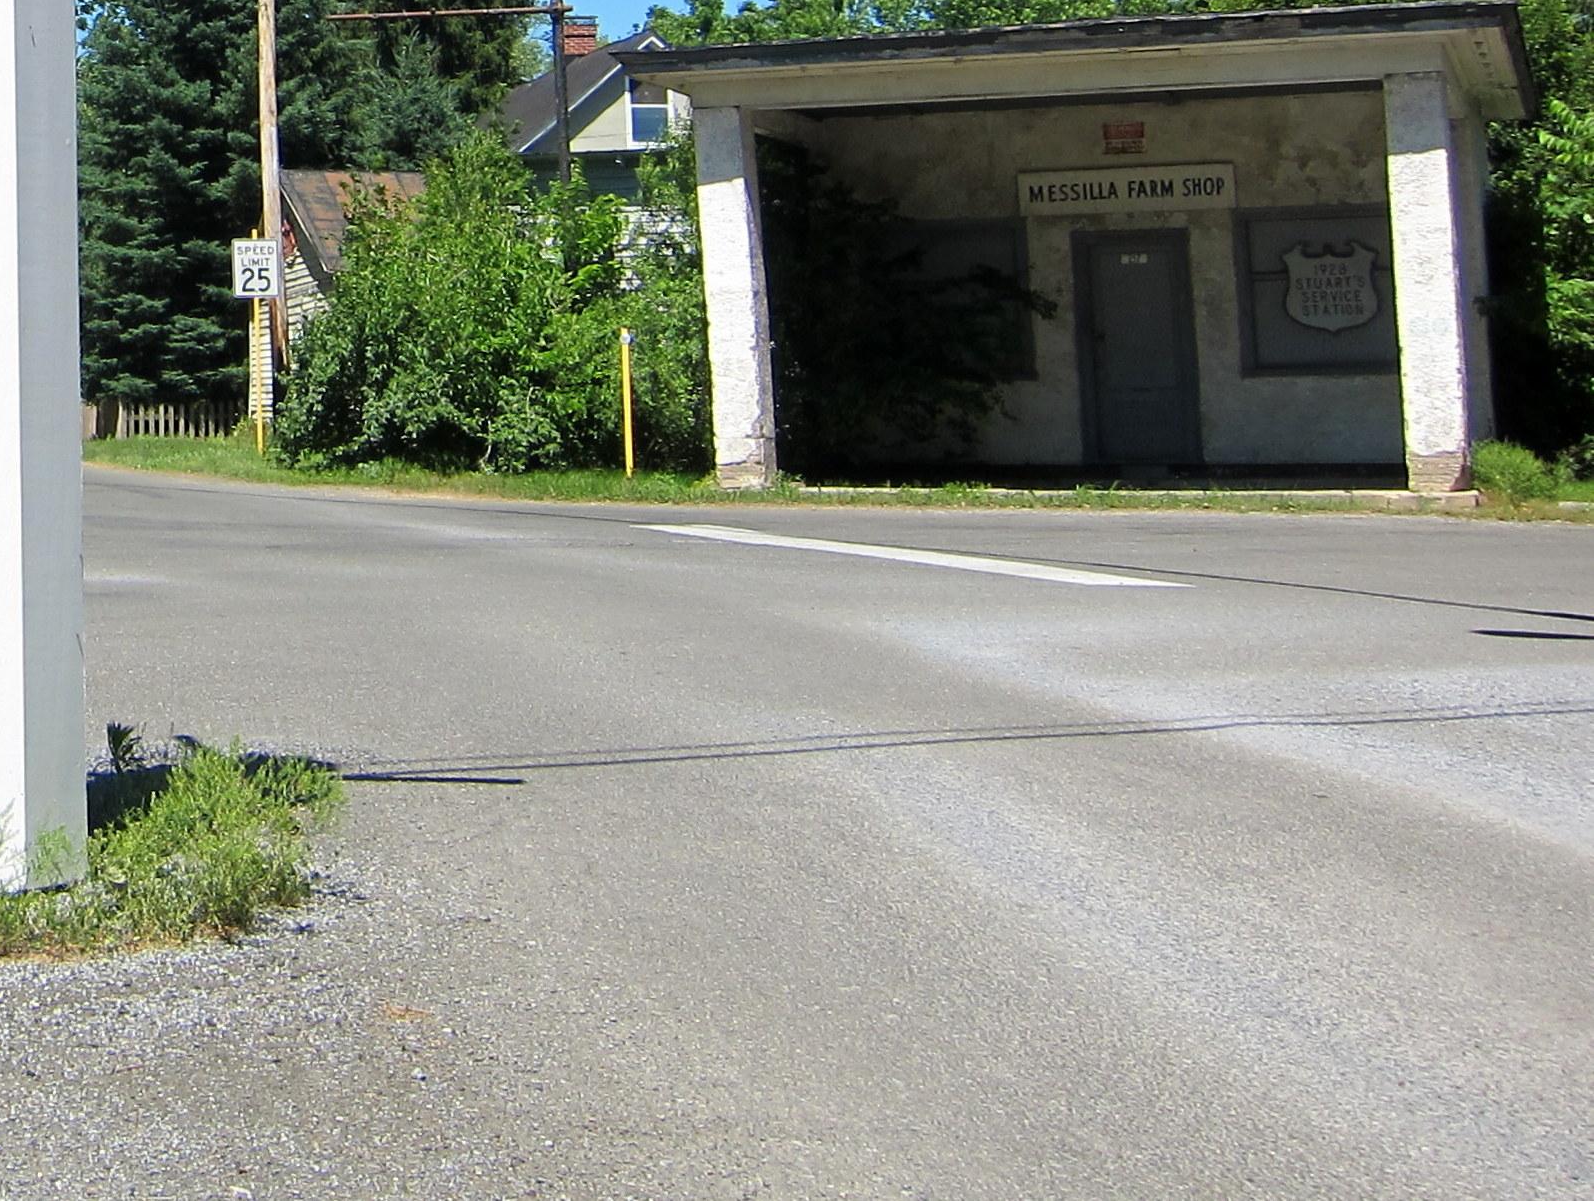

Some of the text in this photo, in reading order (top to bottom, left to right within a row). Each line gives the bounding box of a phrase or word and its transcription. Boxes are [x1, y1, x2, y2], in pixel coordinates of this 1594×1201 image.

[1029, 177, 1225, 203] MESSILLA FARM SHOP
[236, 245, 275, 256] SPEED
[241, 257, 271, 268] LIMIT
[241, 267, 271, 293] 25
[1295, 276, 1366, 289] STUART'S
[1302, 290, 1362, 303] SERVICE
[1302, 304, 1364, 317] STATION
